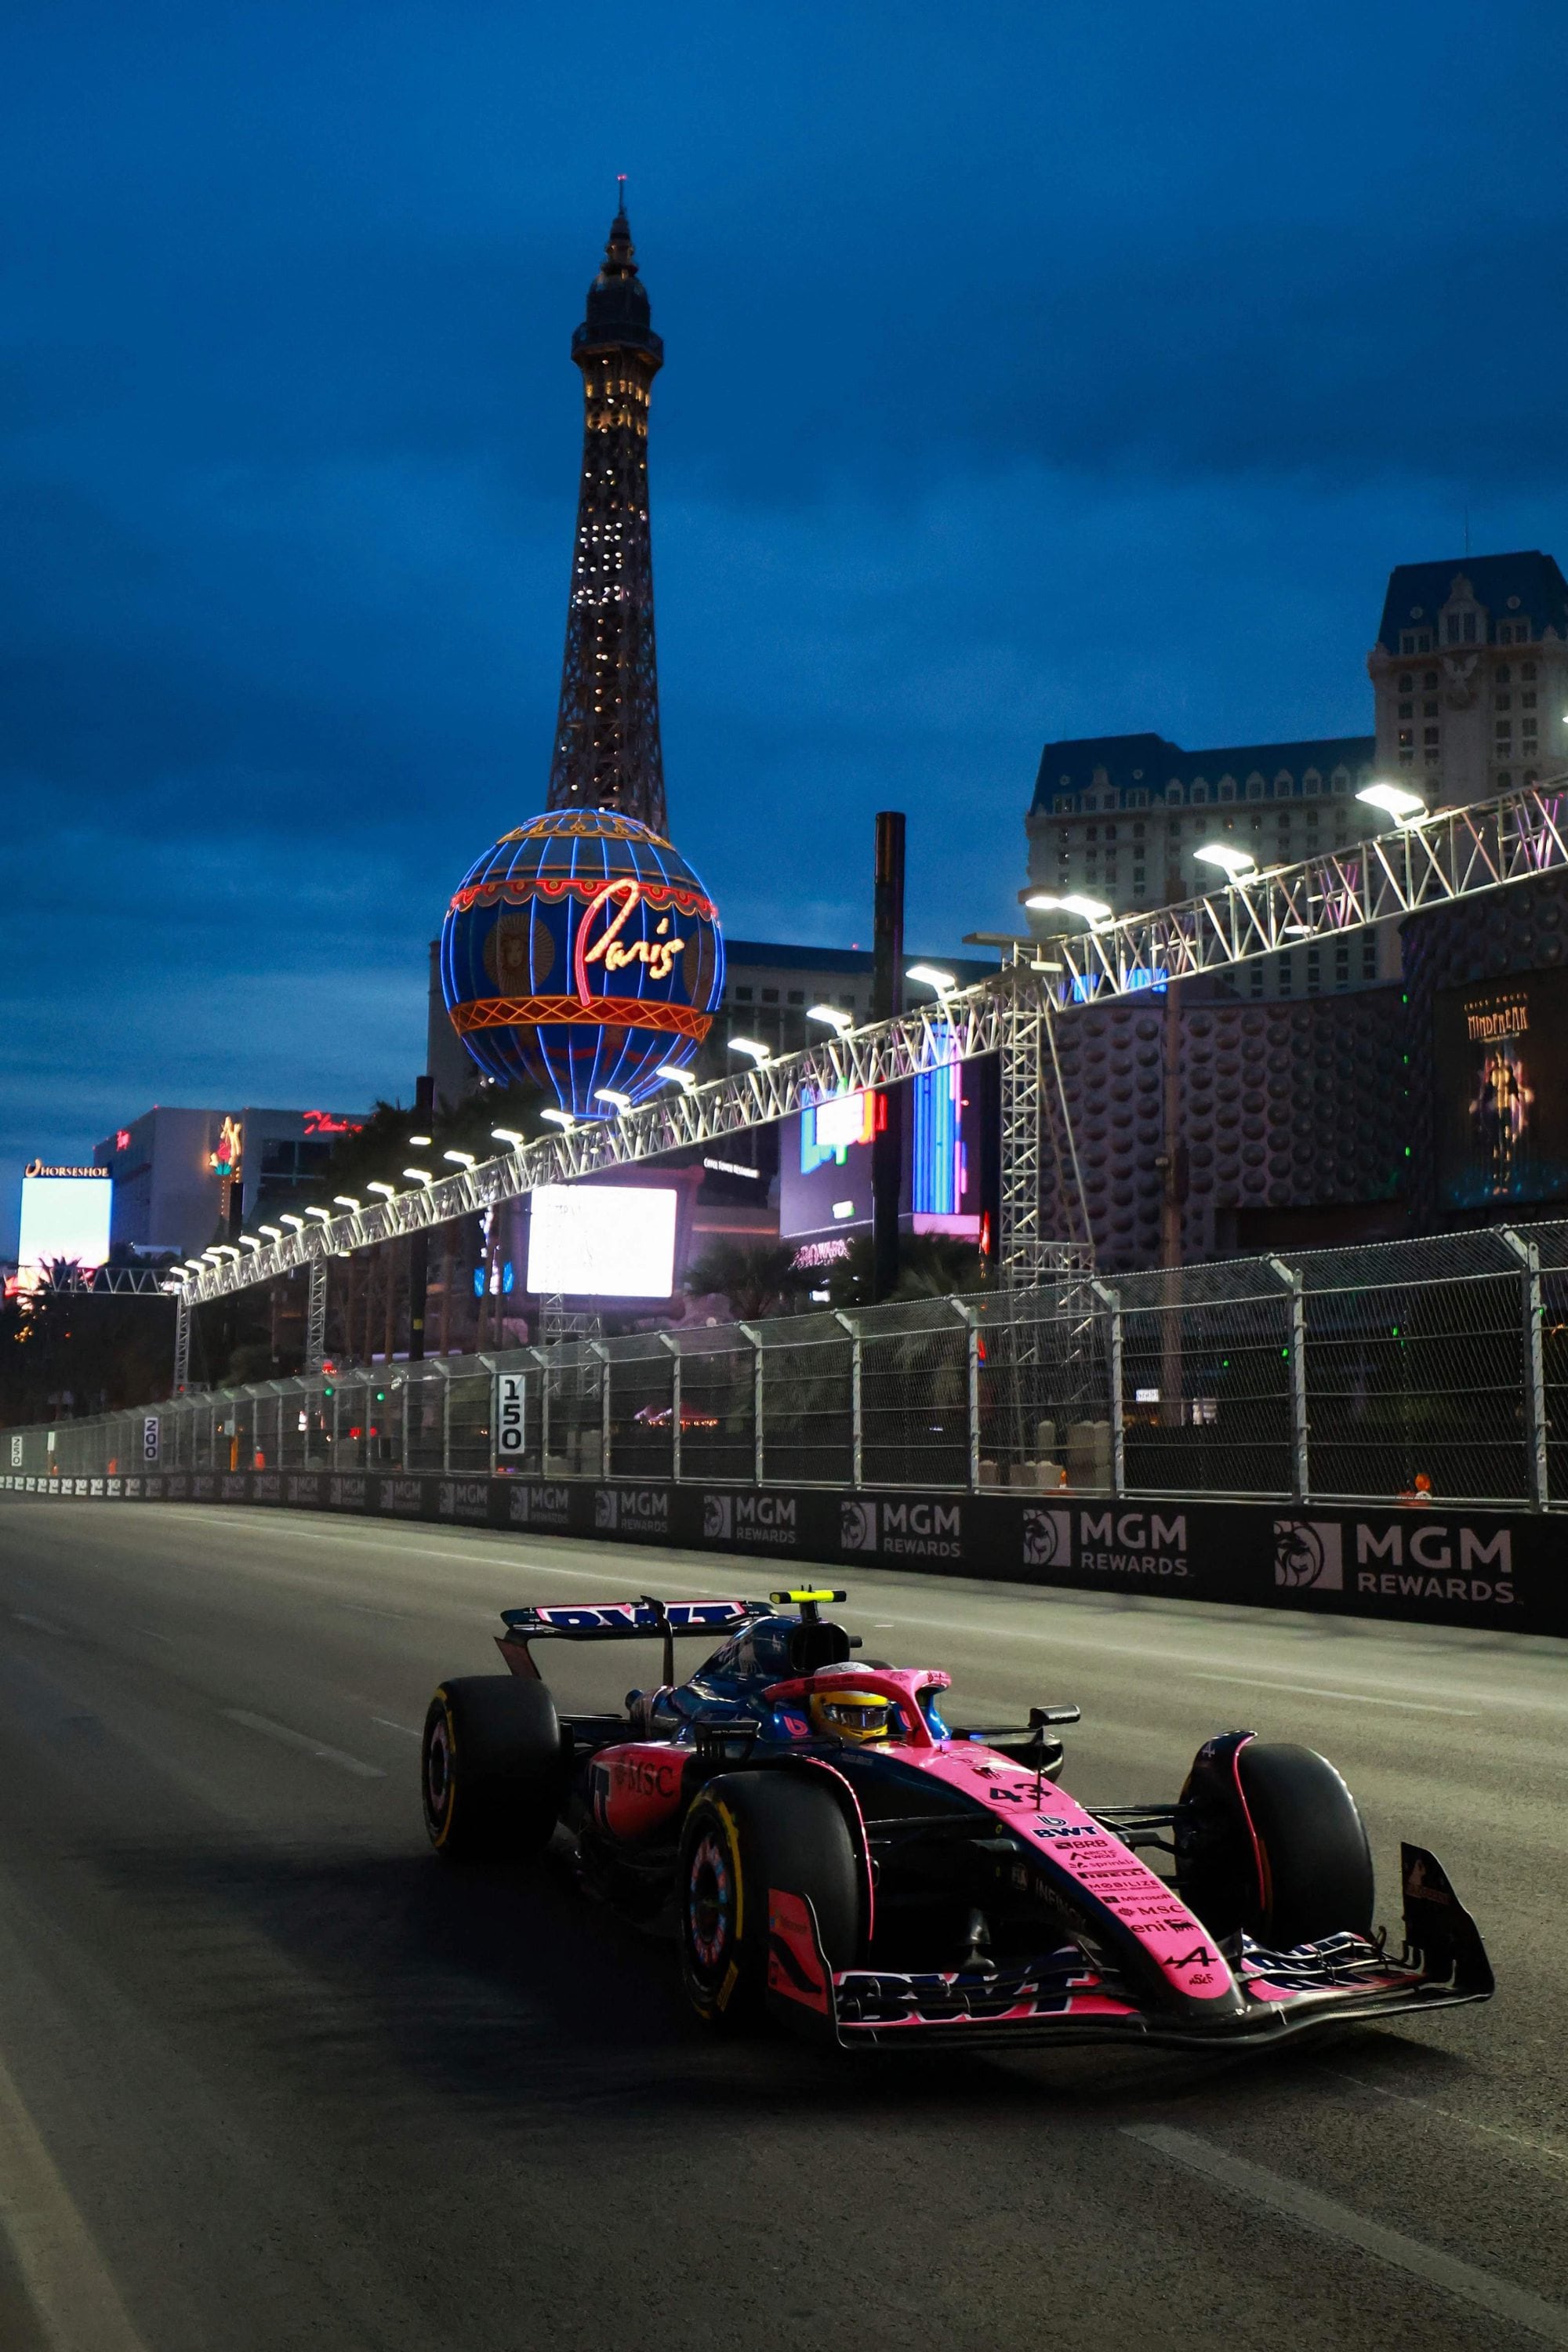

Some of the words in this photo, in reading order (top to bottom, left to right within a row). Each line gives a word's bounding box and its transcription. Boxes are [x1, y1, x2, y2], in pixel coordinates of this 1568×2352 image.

[575, 877, 685, 1007] Paris
[1468, 1006, 1529, 1040] MINDFREAK
[40, 1167, 109, 1177] HORSESHOE
[501, 1379, 521, 1450] 150
[145, 1420, 157, 1458] 200
[456, 1483, 488, 1504] MGM
[531, 1487, 569, 1509] MGM
[621, 1491, 667, 1516] MGM
[736, 1496, 796, 1526] MGM
[883, 1503, 960, 1537] MGM
[621, 1519, 667, 1534] REWARDS
[736, 1527, 797, 1544] REWARDS
[1080, 1511, 1187, 1552] MGM
[884, 1538, 961, 1557] REWARDS
[1356, 1523, 1512, 1573] MGM
[1081, 1552, 1188, 1577] REWARDS
[1357, 1573, 1515, 1603] REWARDS
[628, 1758, 674, 1798] MSC
[989, 1783, 1053, 1802] 43
[1033, 1826, 1098, 1838] BWT
[1072, 1839, 1109, 1849] BRB
[1076, 1868, 1147, 1879] PIRELLI
[1089, 1859, 1134, 1868] sprinklr
[1120, 1893, 1171, 1902] Microsoft
[1137, 1904, 1185, 1915] MSC
[1130, 1920, 1167, 1933] eni
[838, 1946, 1091, 2023] BWT
